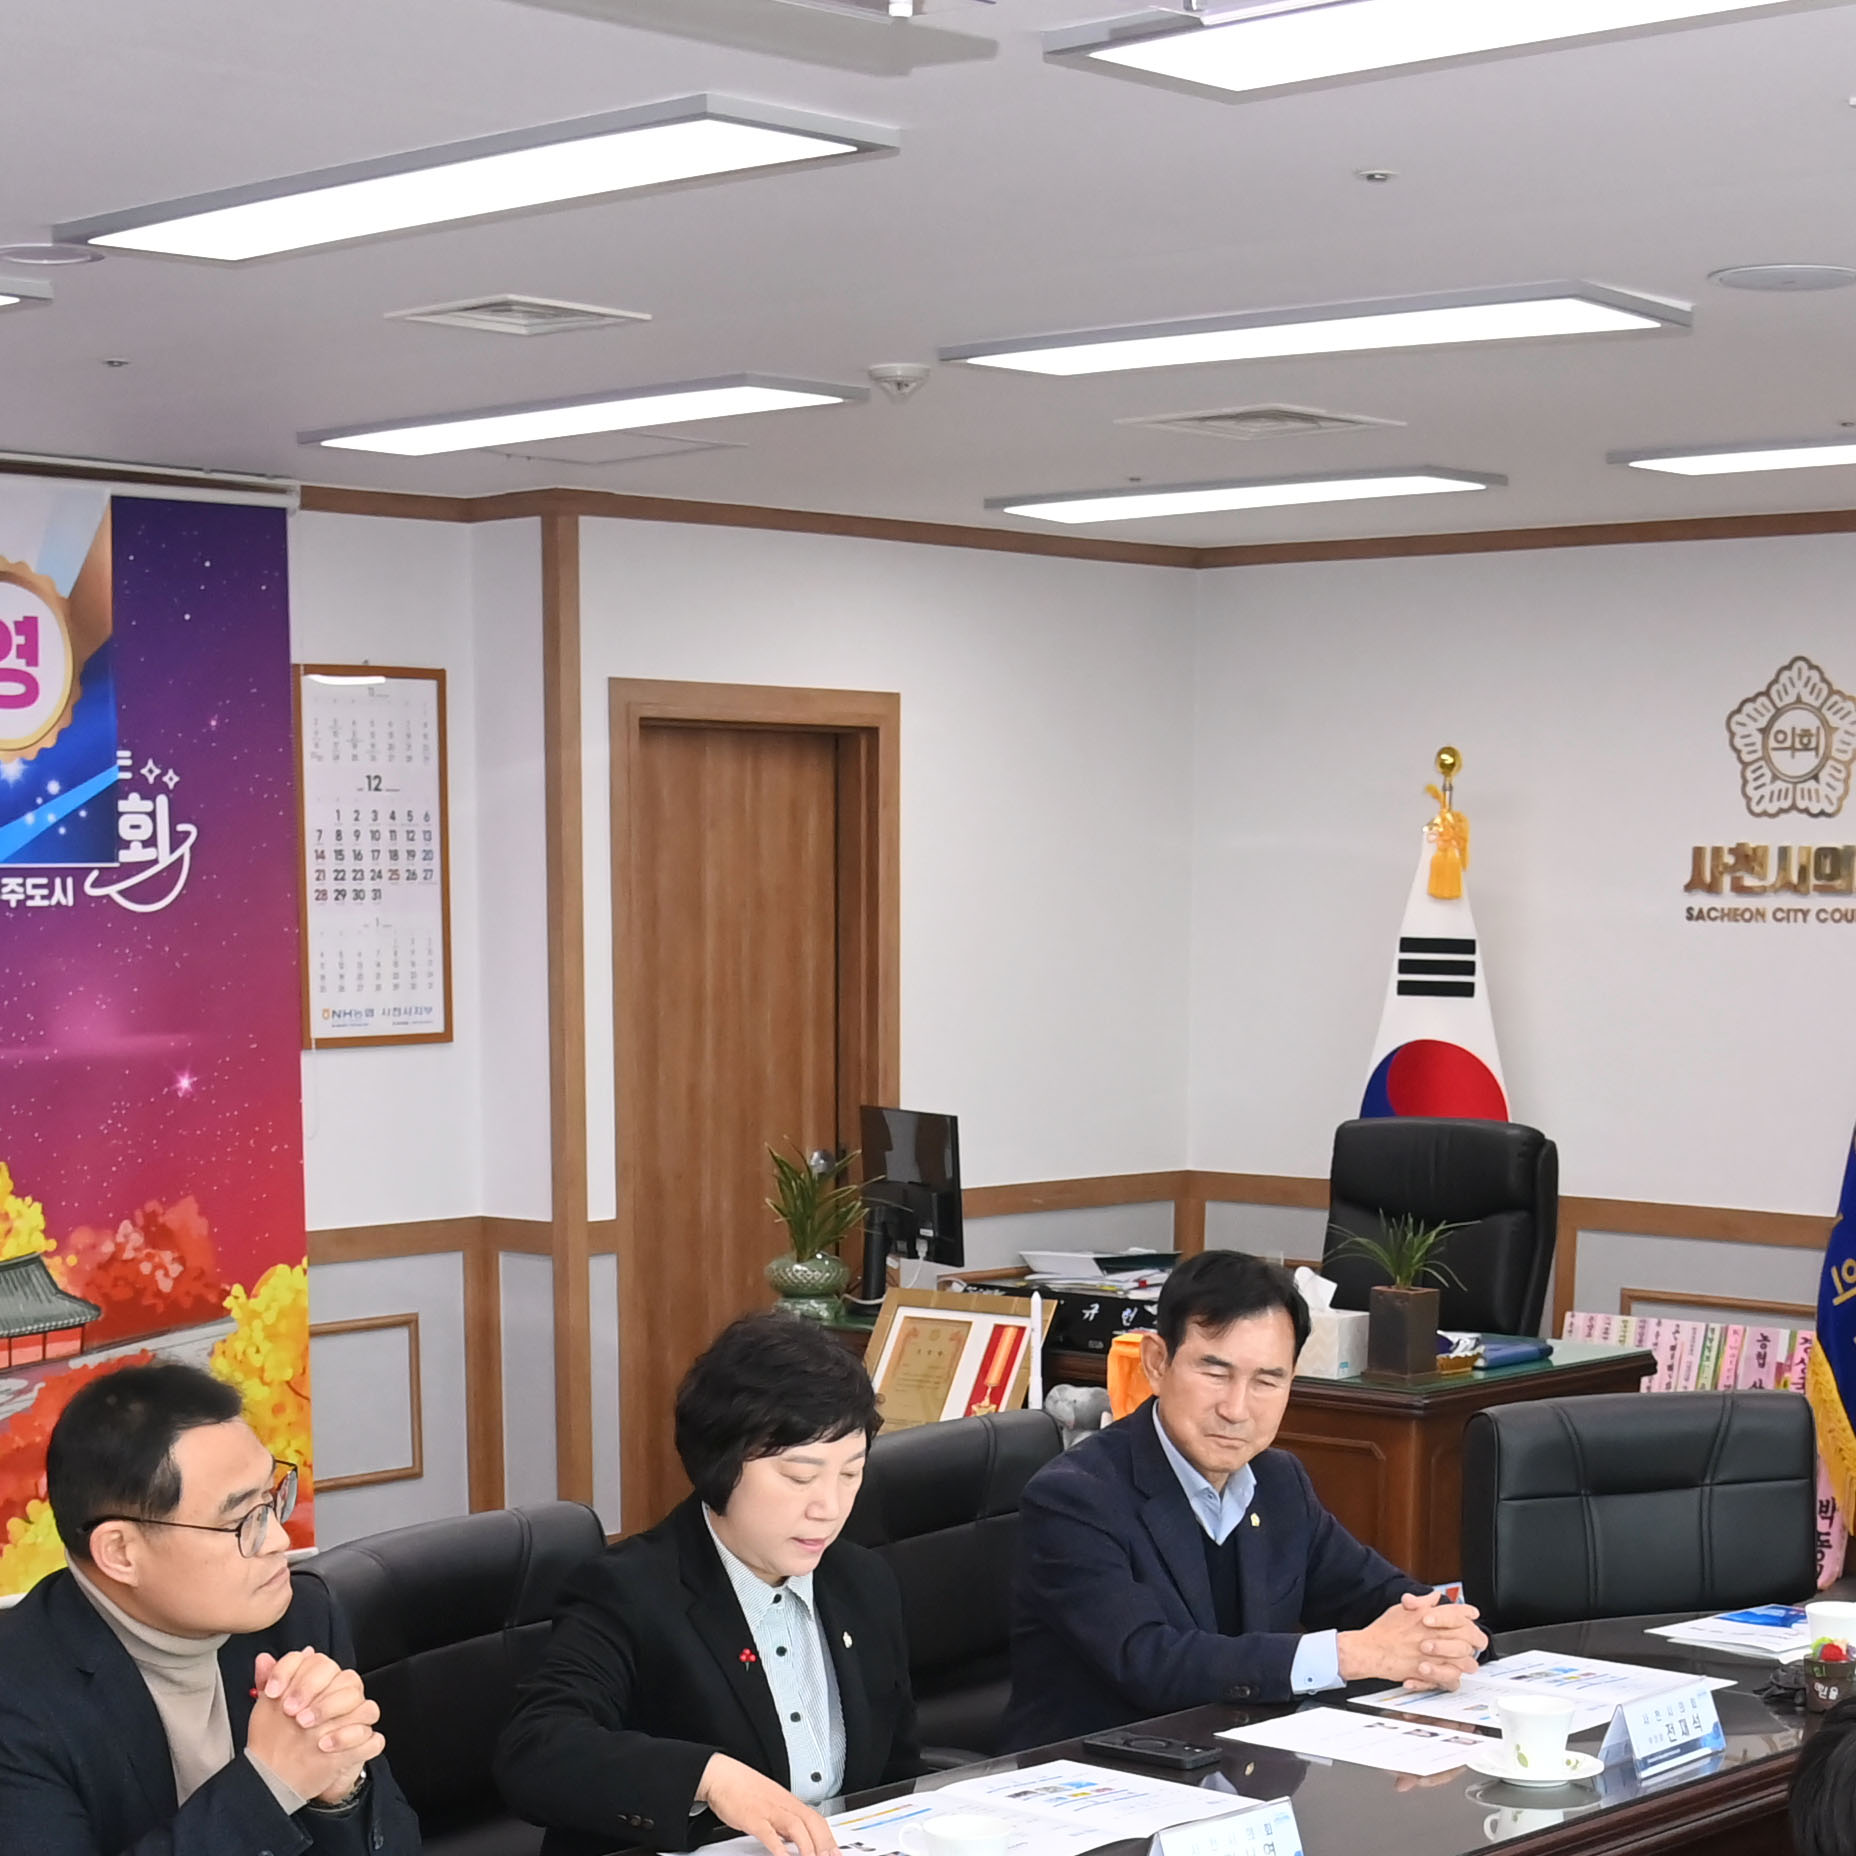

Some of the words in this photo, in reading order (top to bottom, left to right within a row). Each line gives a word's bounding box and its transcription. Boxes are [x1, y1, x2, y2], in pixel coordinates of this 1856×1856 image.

[1771, 726, 1821, 760] 의회
[365, 774, 383, 792] 12
[1685, 906, 1767, 922] SACHEON
[1772, 907, 1811, 923] CITY
